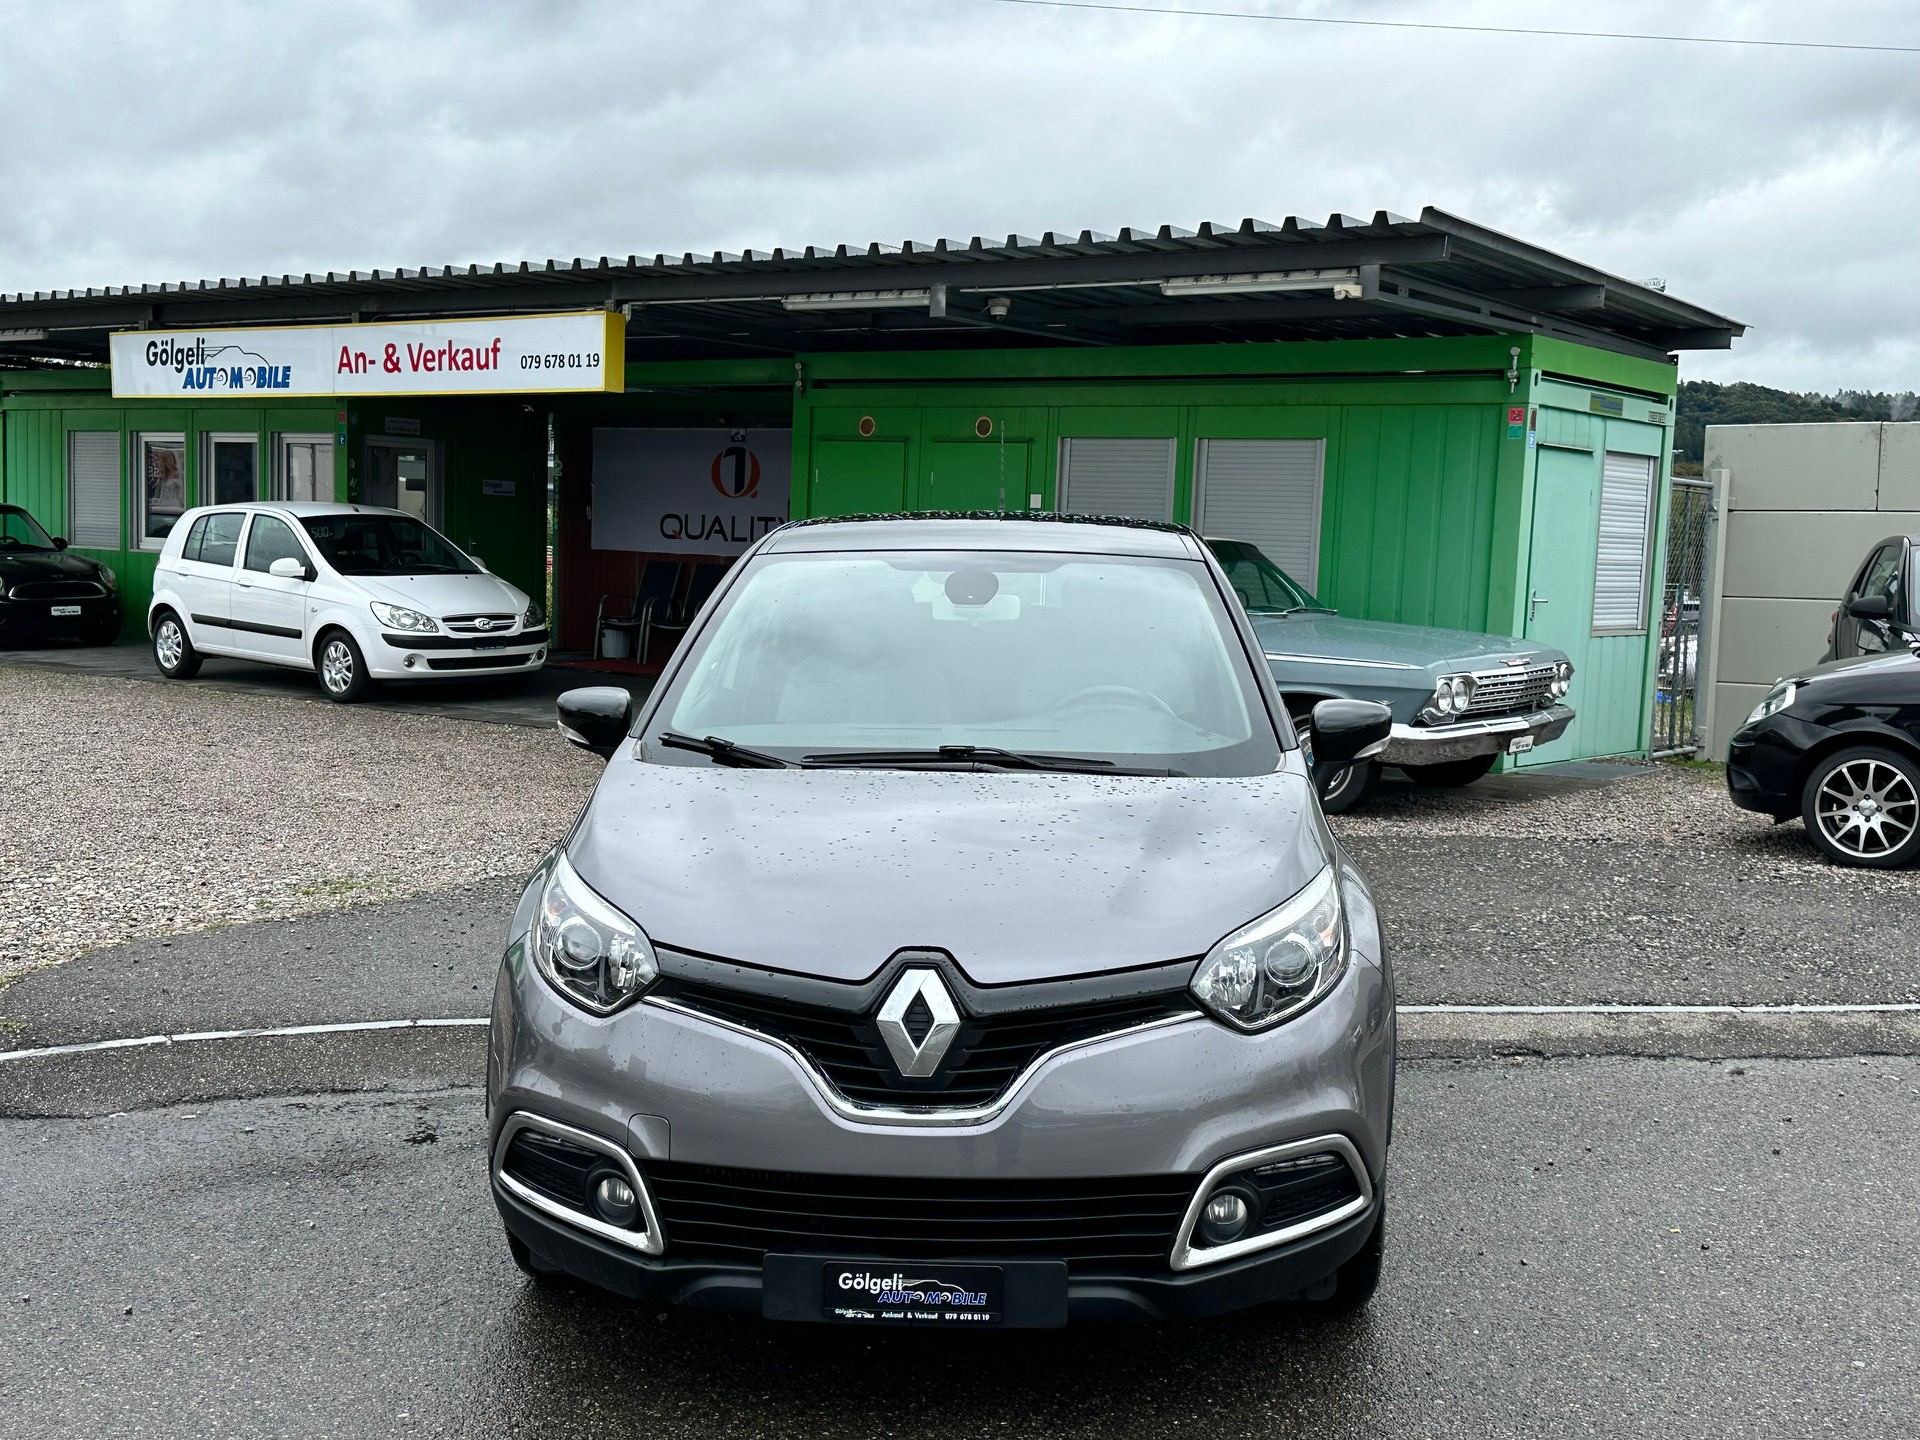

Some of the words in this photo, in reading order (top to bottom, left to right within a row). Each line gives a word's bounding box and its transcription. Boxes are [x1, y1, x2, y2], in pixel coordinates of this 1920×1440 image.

[146, 337, 206, 373] Gölgeli
[337, 345, 377, 374] An-
[382, 343, 402, 374] &
[407, 337, 501, 372] Verkauf
[520, 355, 541, 370] 079
[544, 354, 565, 369] 678
[568, 354, 582, 368] 01
[586, 353, 600, 368] 19
[182, 366, 291, 389] AUTOMOBILE
[660, 513, 788, 542] QUALIT
[838, 1272, 903, 1294] Gölgeli
[877, 1291, 987, 1305] AUTOMOBILE
